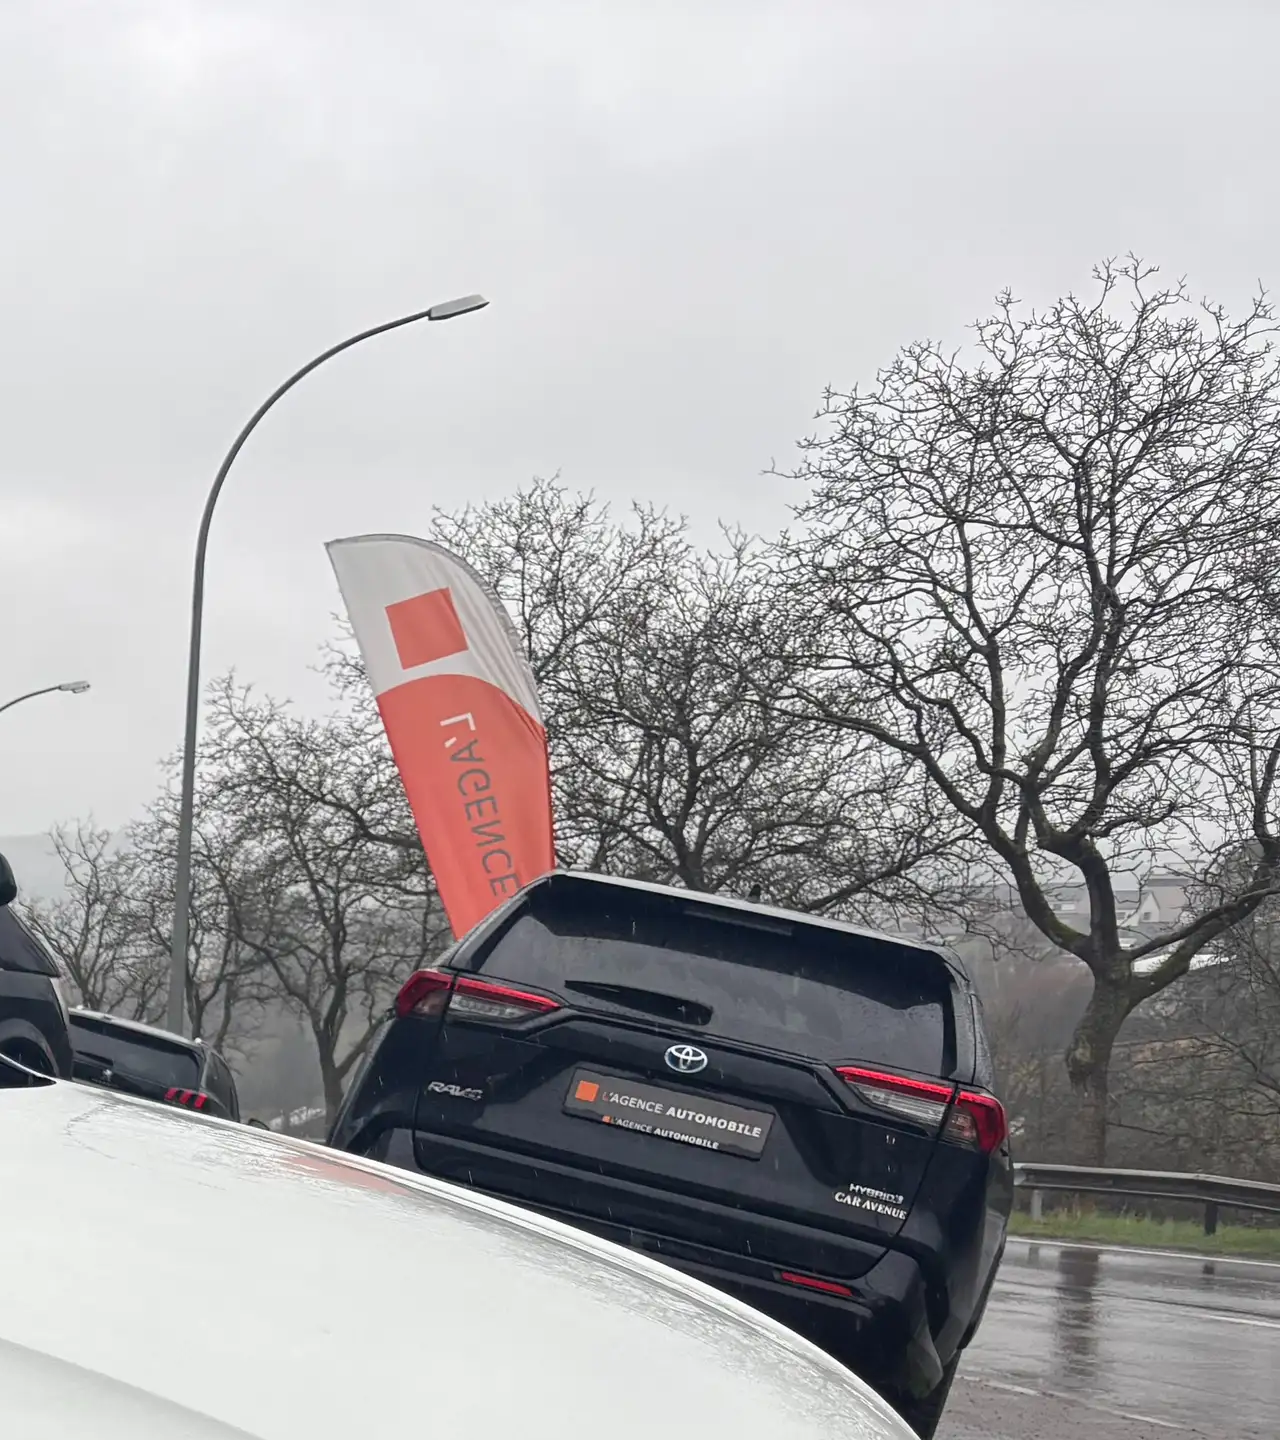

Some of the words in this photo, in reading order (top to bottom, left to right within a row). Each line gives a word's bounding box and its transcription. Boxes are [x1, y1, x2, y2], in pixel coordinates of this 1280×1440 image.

[602, 1091, 664, 1114] L'AGENCE
[665, 1106, 762, 1138] AUTOMOBILE
[653, 1127, 720, 1150] AUTOMOBILE
[834, 1191, 861, 1207] CAR
[862, 1200, 908, 1220] AVENUE
